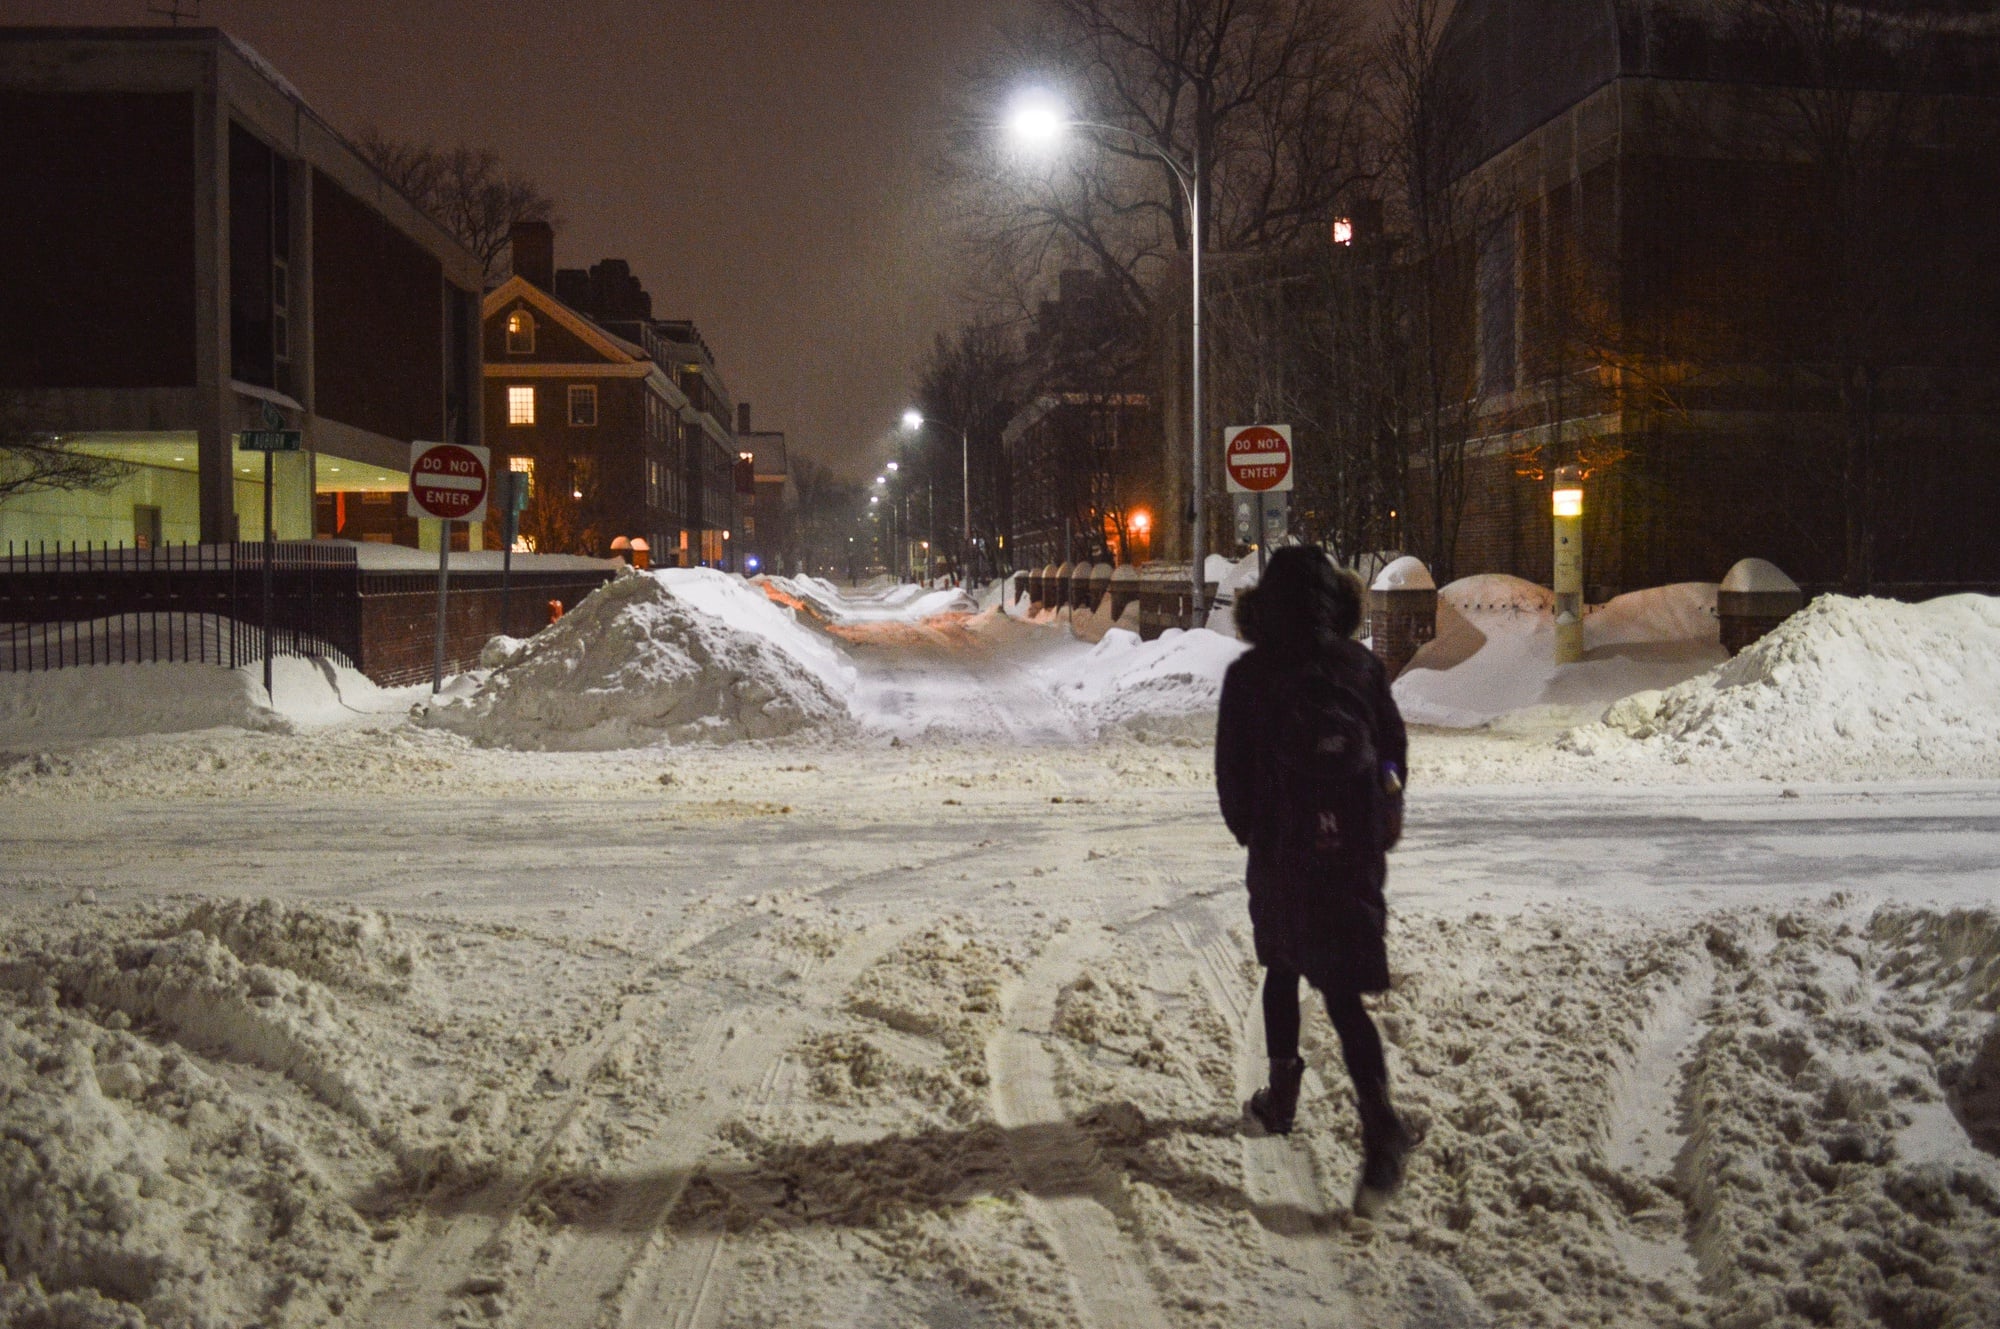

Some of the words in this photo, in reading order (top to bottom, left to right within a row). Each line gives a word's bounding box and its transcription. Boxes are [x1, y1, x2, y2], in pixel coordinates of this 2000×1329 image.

[1235, 440, 1251, 450] DO
[1257, 438, 1280, 449] NOT
[423, 457, 442, 470] DO
[450, 460, 477, 473] NOT
[1240, 467, 1277, 479] ENTER
[426, 490, 470, 505] ENTER
